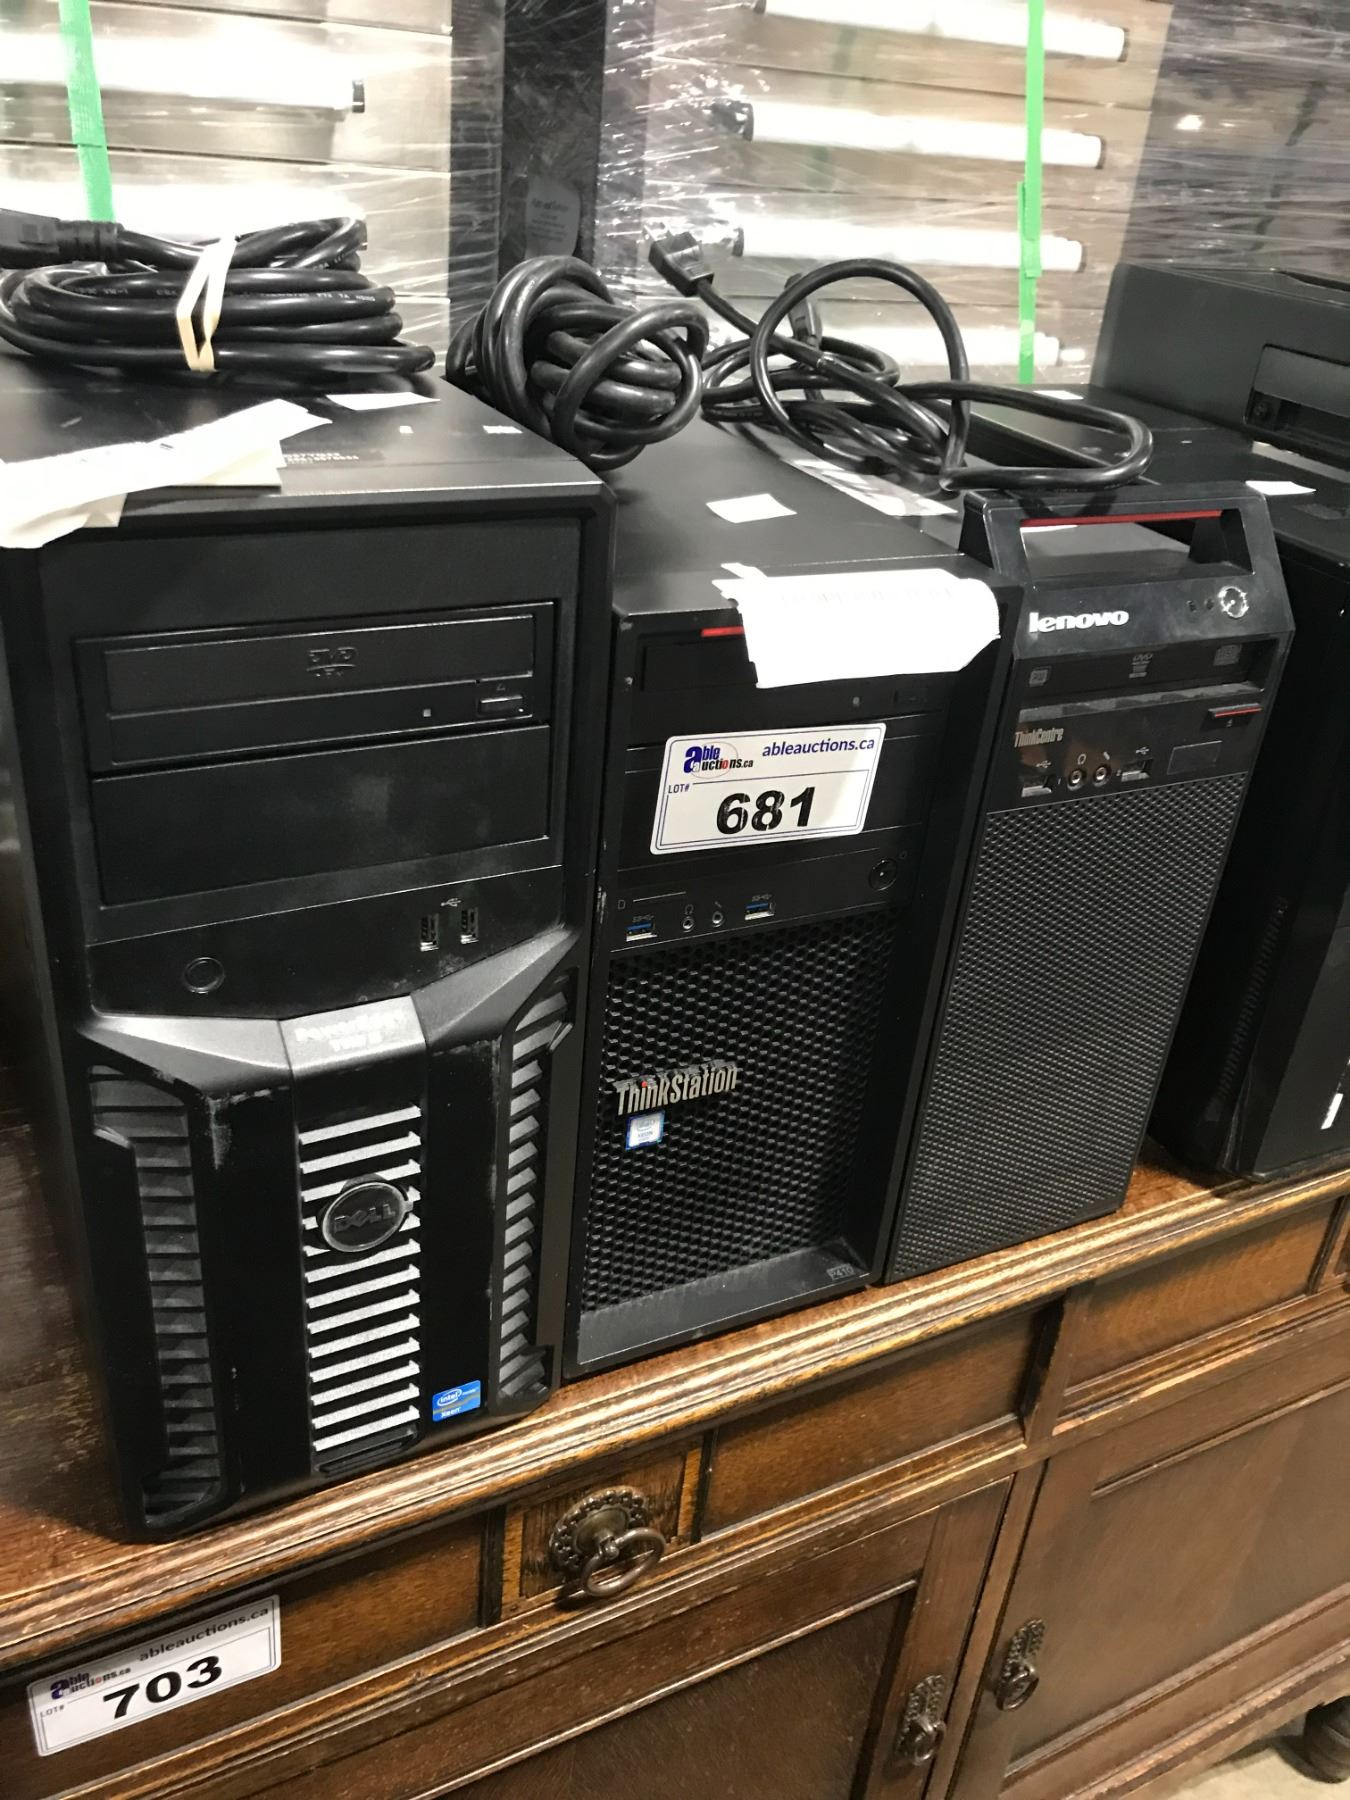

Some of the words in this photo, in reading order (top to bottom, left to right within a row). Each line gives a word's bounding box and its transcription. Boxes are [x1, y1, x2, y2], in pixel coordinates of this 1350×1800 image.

[1028, 610, 1130, 633] lenovo
[762, 738, 875, 757] ableauctions.ca
[1014, 727, 1065, 749] ThinkCentre
[668, 783, 690, 794] LOT#
[716, 786, 816, 835] 681
[616, 1065, 739, 1116] ThinkStation
[334, 1203, 396, 1233] DELL
[138, 1607, 269, 1662] ableauctions.ca
[102, 1655, 223, 1719] 703
